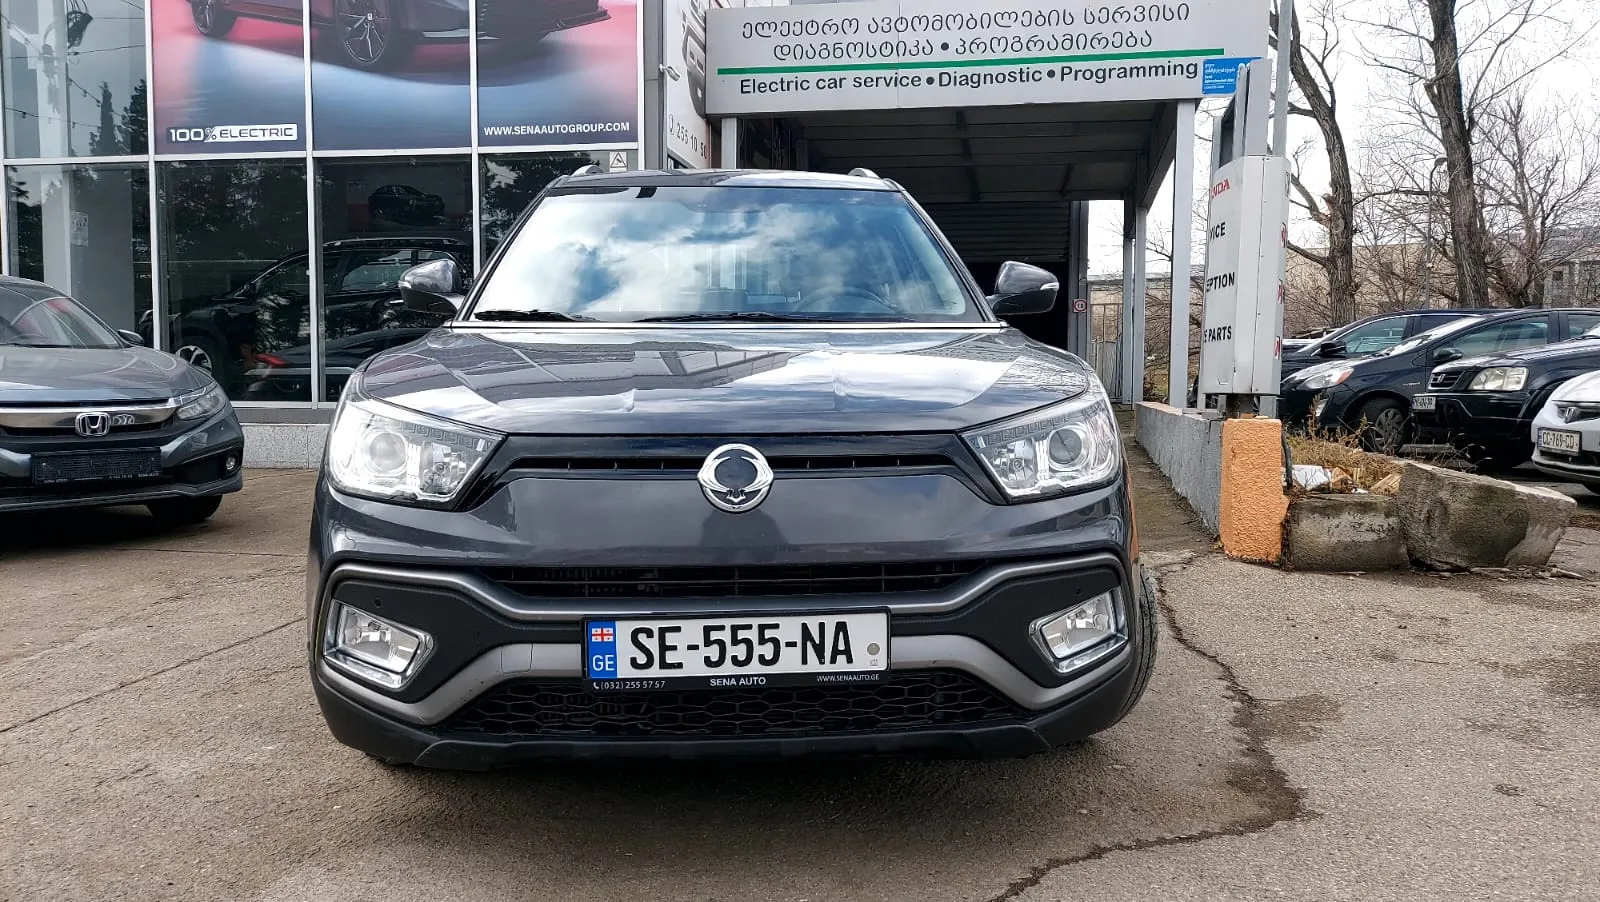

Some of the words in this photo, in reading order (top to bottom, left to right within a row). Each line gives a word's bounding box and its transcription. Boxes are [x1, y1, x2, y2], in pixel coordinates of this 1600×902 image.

[742, 17, 859, 39] ელექტრო
[867, 9, 1074, 34] ავტომობილების
[1084, 3, 1190, 25] სერვისი
[773, 38, 934, 61] დიაგნოსტიკა
[955, 30, 1153, 55] პროგრამირება
[740, 76, 810, 94] Electric
[815, 76, 847, 89] car
[853, 72, 922, 88] service
[938, 67, 1042, 89] Diagnostic
[1060, 61, 1198, 84] Programming
[170, 127, 217, 142] 100%
[219, 128, 294, 139] ELECTRIC
[484, 122, 630, 136] WWW.SENAAUTOGROUP.COM
[677, 122, 689, 145] 255
[691, 134, 698, 152] 10
[1208, 325, 1232, 342] PARTS
[592, 654, 616, 671] GE
[629, 621, 854, 671] SE-555-NA
[600, 681, 624, 690] (032)
[625, 681, 641, 689] 255
[709, 678, 737, 687] SENA
[739, 676, 767, 686] AUTO
[816, 673, 880, 682] WWW.SENAAUTO.GE
